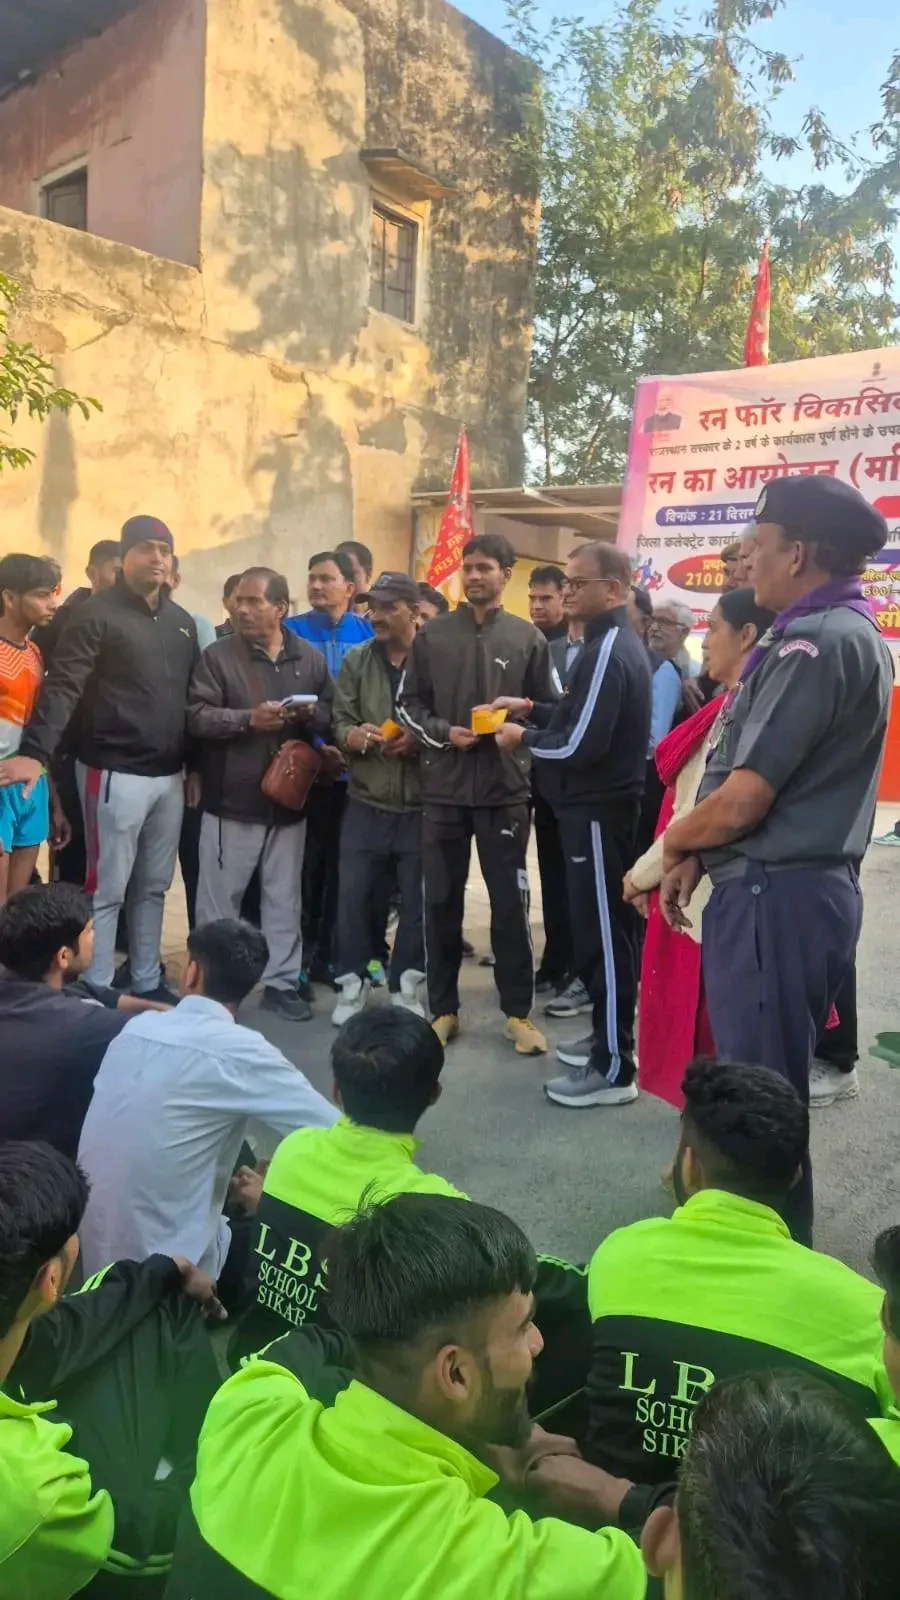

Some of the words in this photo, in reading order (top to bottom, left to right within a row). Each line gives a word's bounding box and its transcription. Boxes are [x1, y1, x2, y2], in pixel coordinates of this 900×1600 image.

[699, 407, 728, 431] रन
[735, 396, 787, 428] फॉर
[690, 442, 720, 454] सरकार
[722, 438, 732, 451] के
[735, 440, 741, 450] 2
[744, 435, 758, 449] वर्ष
[760, 434, 770, 448] के
[772, 431, 816, 446] कार्यकाल
[818, 426, 837, 446] पूर्ण
[839, 425, 860, 441] होने
[862, 424, 874, 438] के
[648, 471, 677, 494] रन
[683, 468, 717, 493] का
[665, 508, 698, 523] दिनांक
[708, 510, 722, 521] 21
[636, 533, 661, 548] जिला
[257, 1261, 318, 1312] SCHOOL
[257, 1284, 306, 1327] SIKAR
[635, 1397, 693, 1433] SCH
